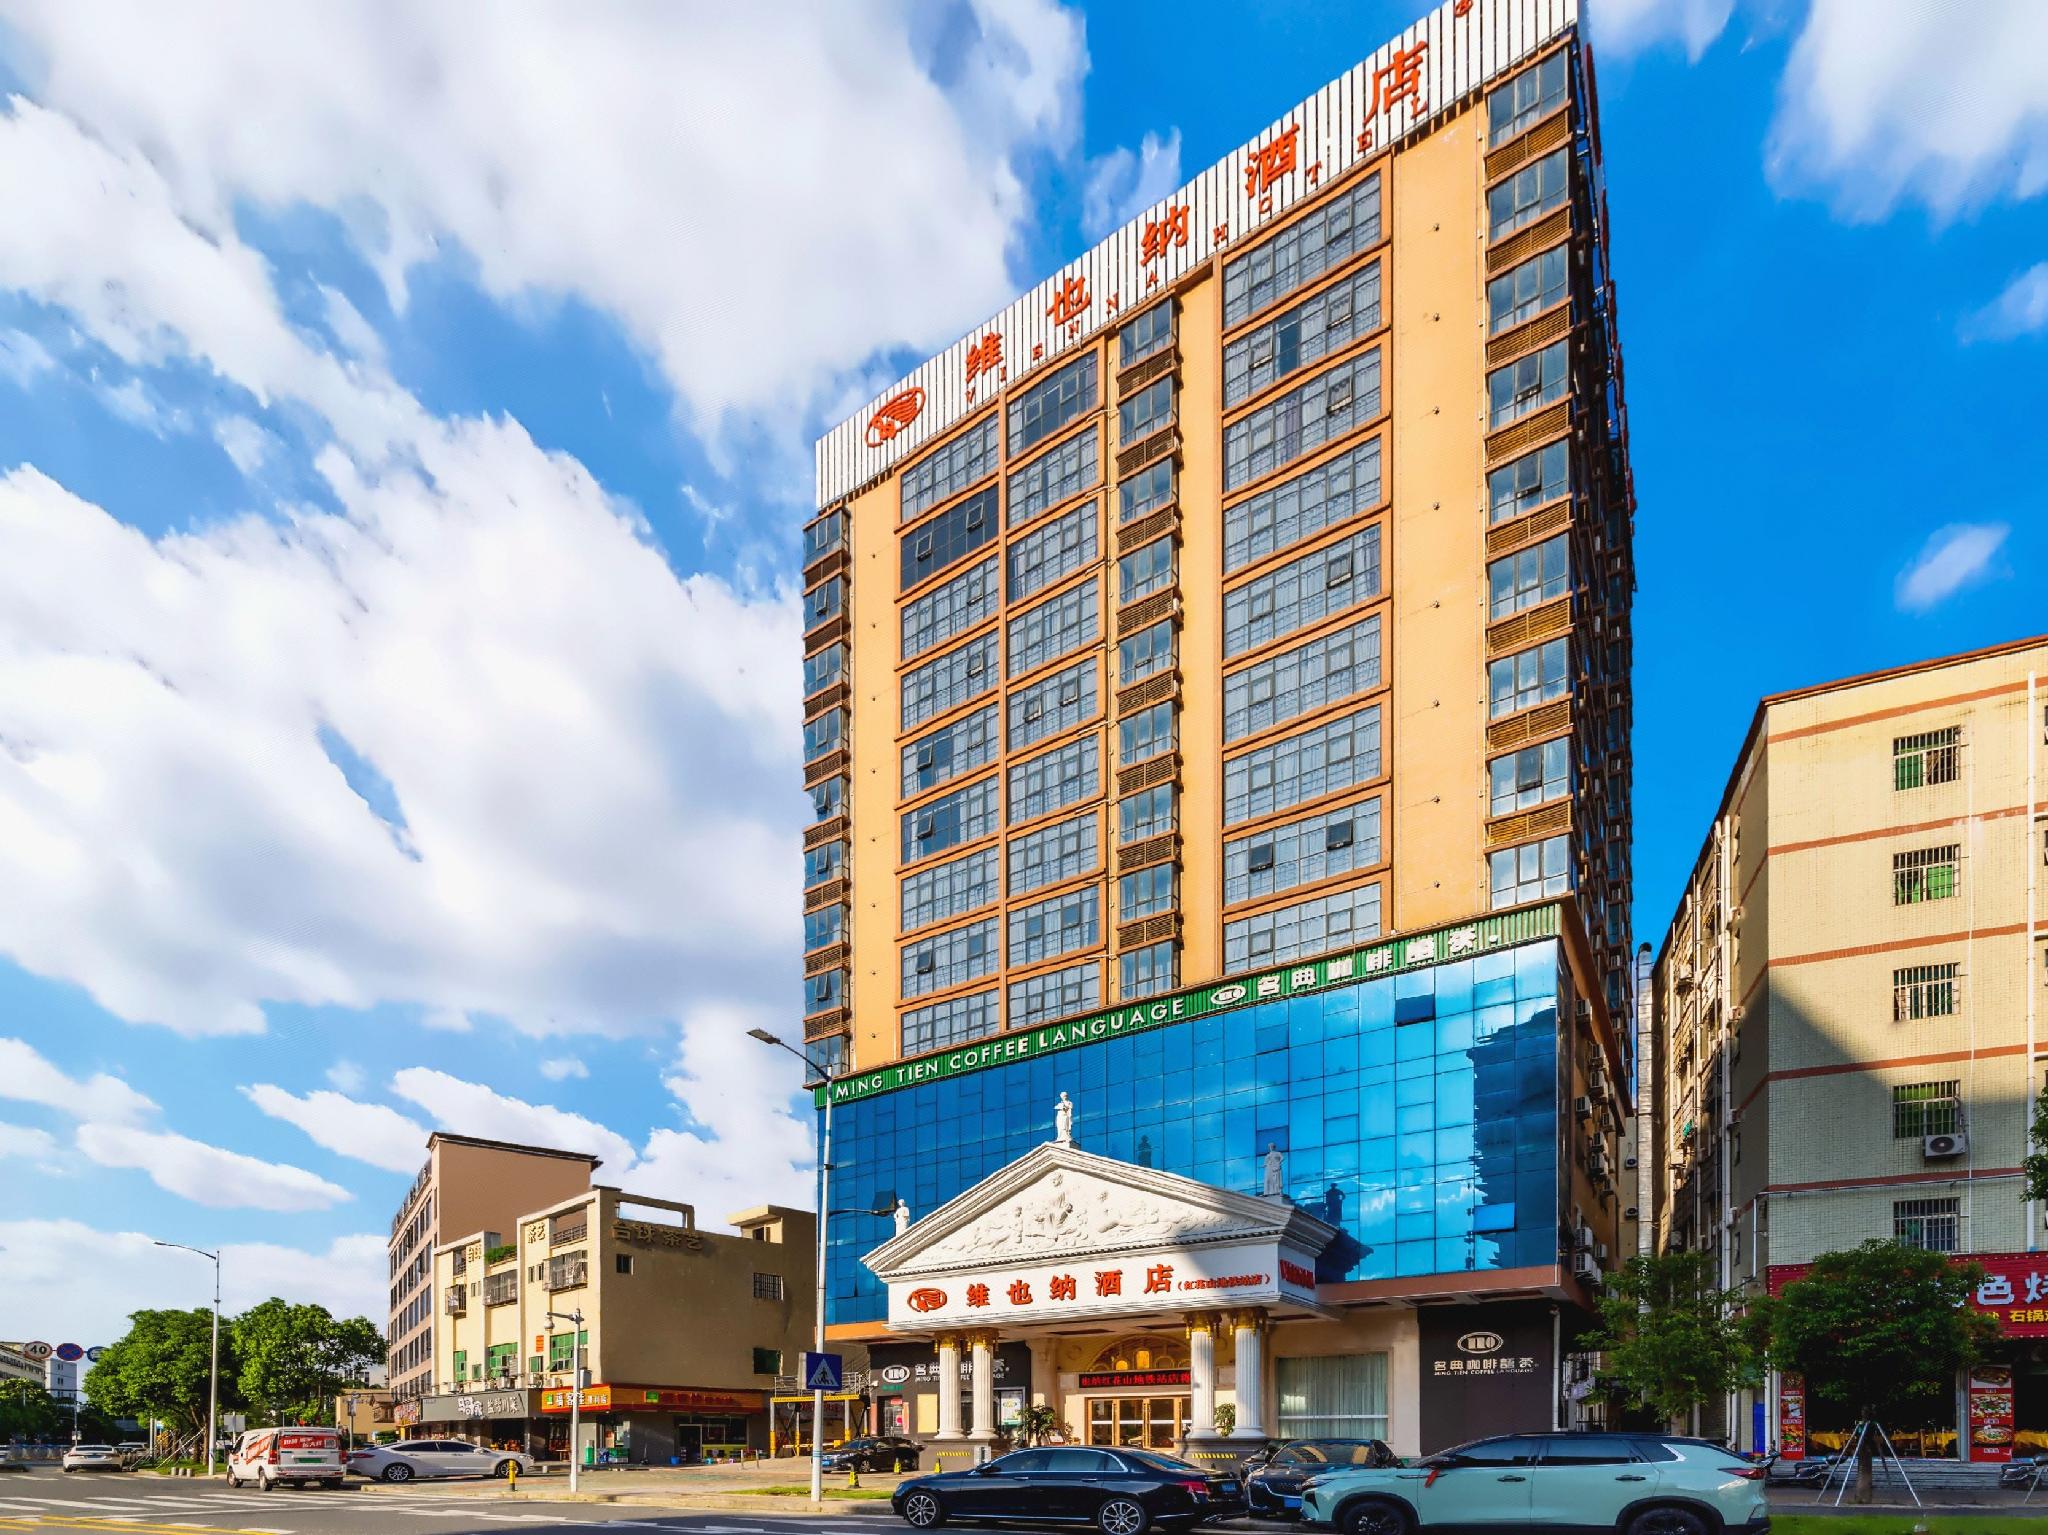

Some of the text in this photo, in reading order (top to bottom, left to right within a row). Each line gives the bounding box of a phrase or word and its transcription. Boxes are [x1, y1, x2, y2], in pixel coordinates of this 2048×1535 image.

[966, 41, 1428, 383] 维也纳酒店
[966, 96, 1428, 403] VIENNA HOTEL
[835, 999, 1185, 1099] MING TIEN COFFEE LANGUAGE
[966, 1263, 1175, 1308] 维也纳酒店
[2009, 1309, 2048, 1322] 石锅
[30, 1345, 47, 1354] 40
